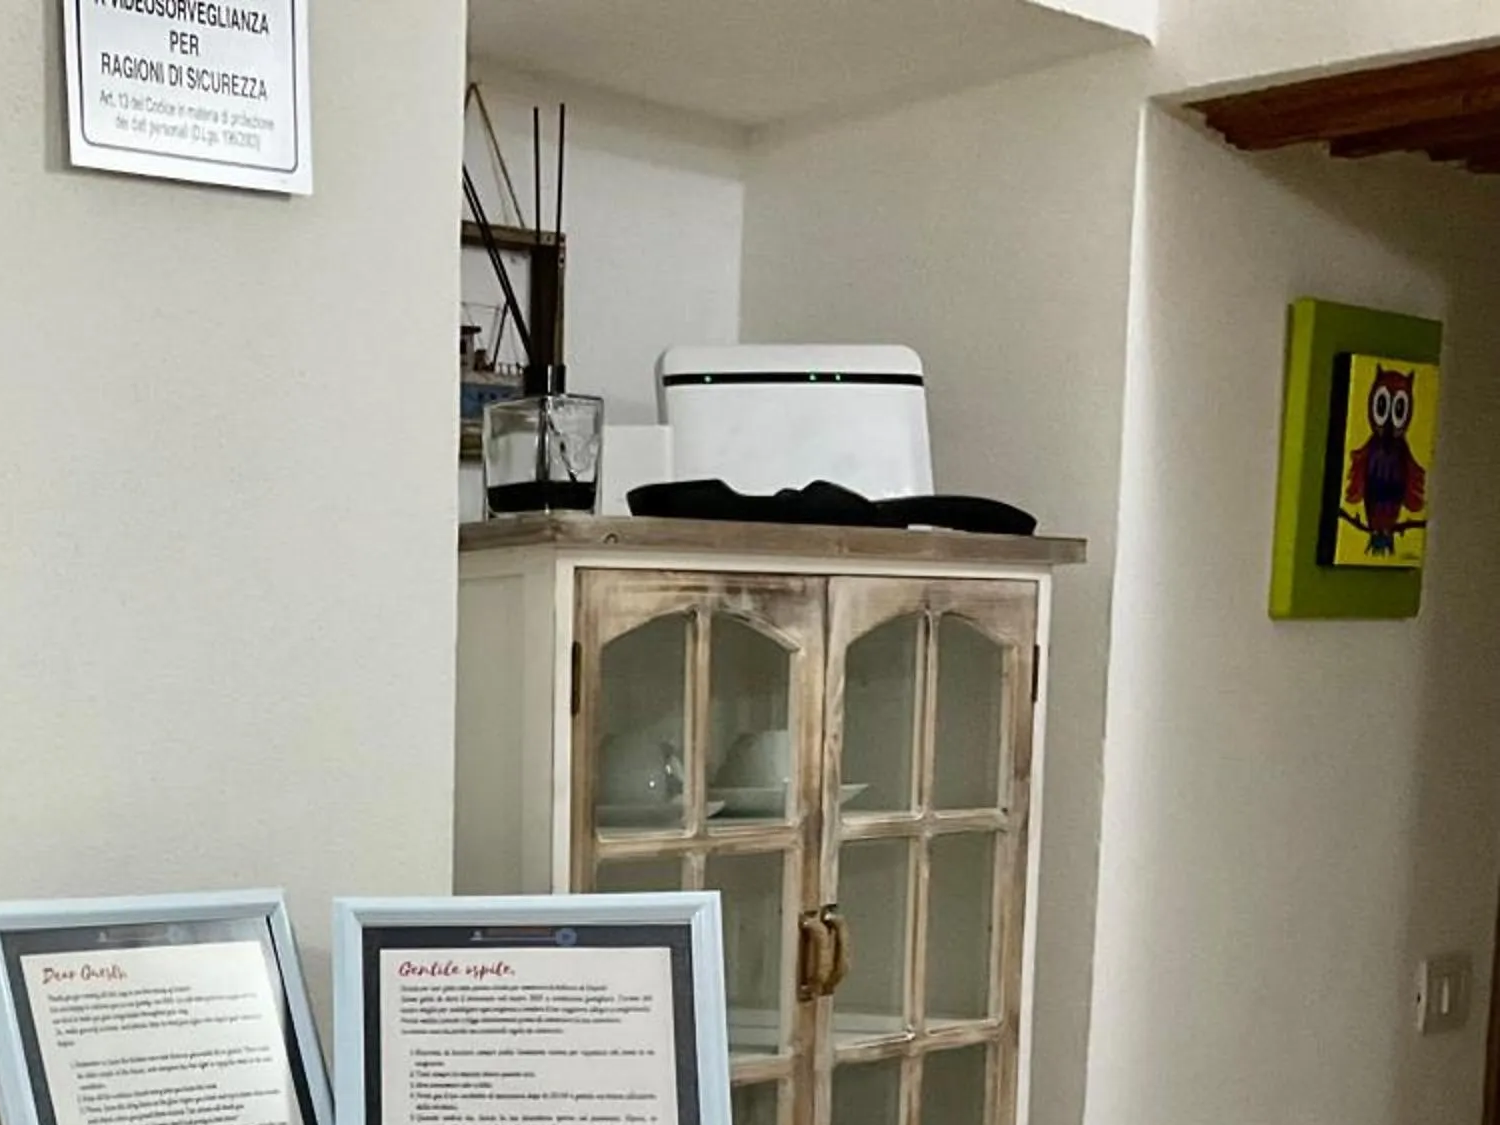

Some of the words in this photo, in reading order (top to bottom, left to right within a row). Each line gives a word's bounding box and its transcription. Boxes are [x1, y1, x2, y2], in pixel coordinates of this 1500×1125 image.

[169, 31, 199, 56] PER
[101, 53, 164, 86] RAGIONI
[169, 64, 183, 87] DI
[187, 66, 268, 100] SICUREZZA
[43, 967, 77, 984] Dear
[398, 960, 460, 977] Gentile
